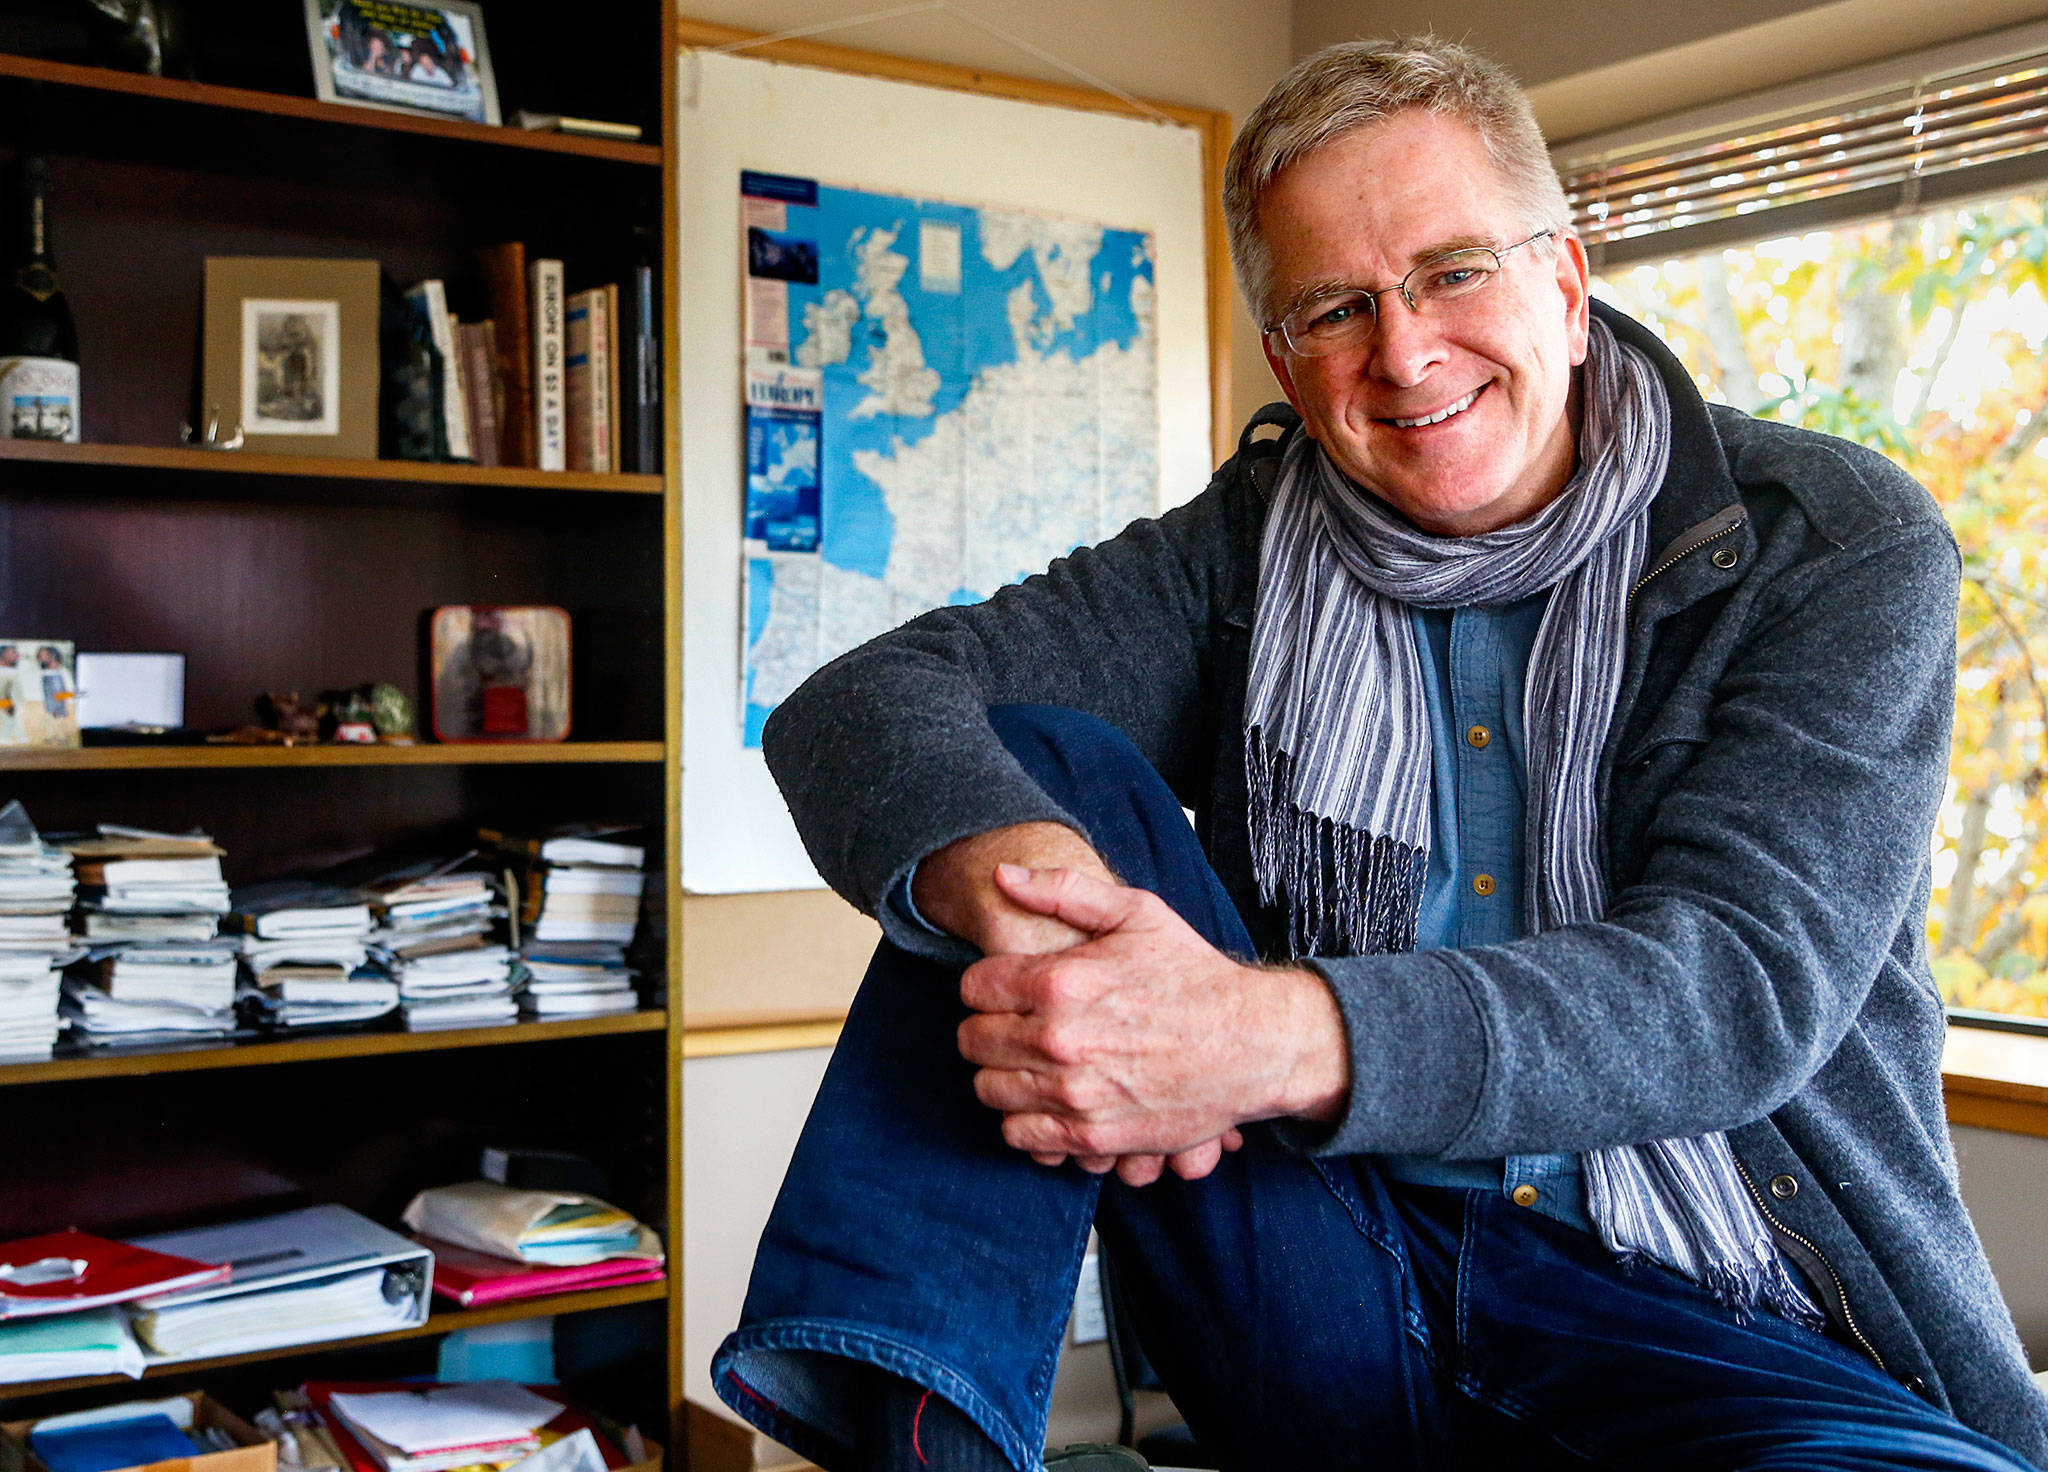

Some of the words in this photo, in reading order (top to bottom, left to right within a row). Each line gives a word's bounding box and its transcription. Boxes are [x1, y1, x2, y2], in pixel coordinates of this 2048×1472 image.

[544, 274, 559, 335] EUROPE
[544, 341, 559, 367] ON
[546, 398, 558, 409] A
[546, 415, 559, 449] DAY
